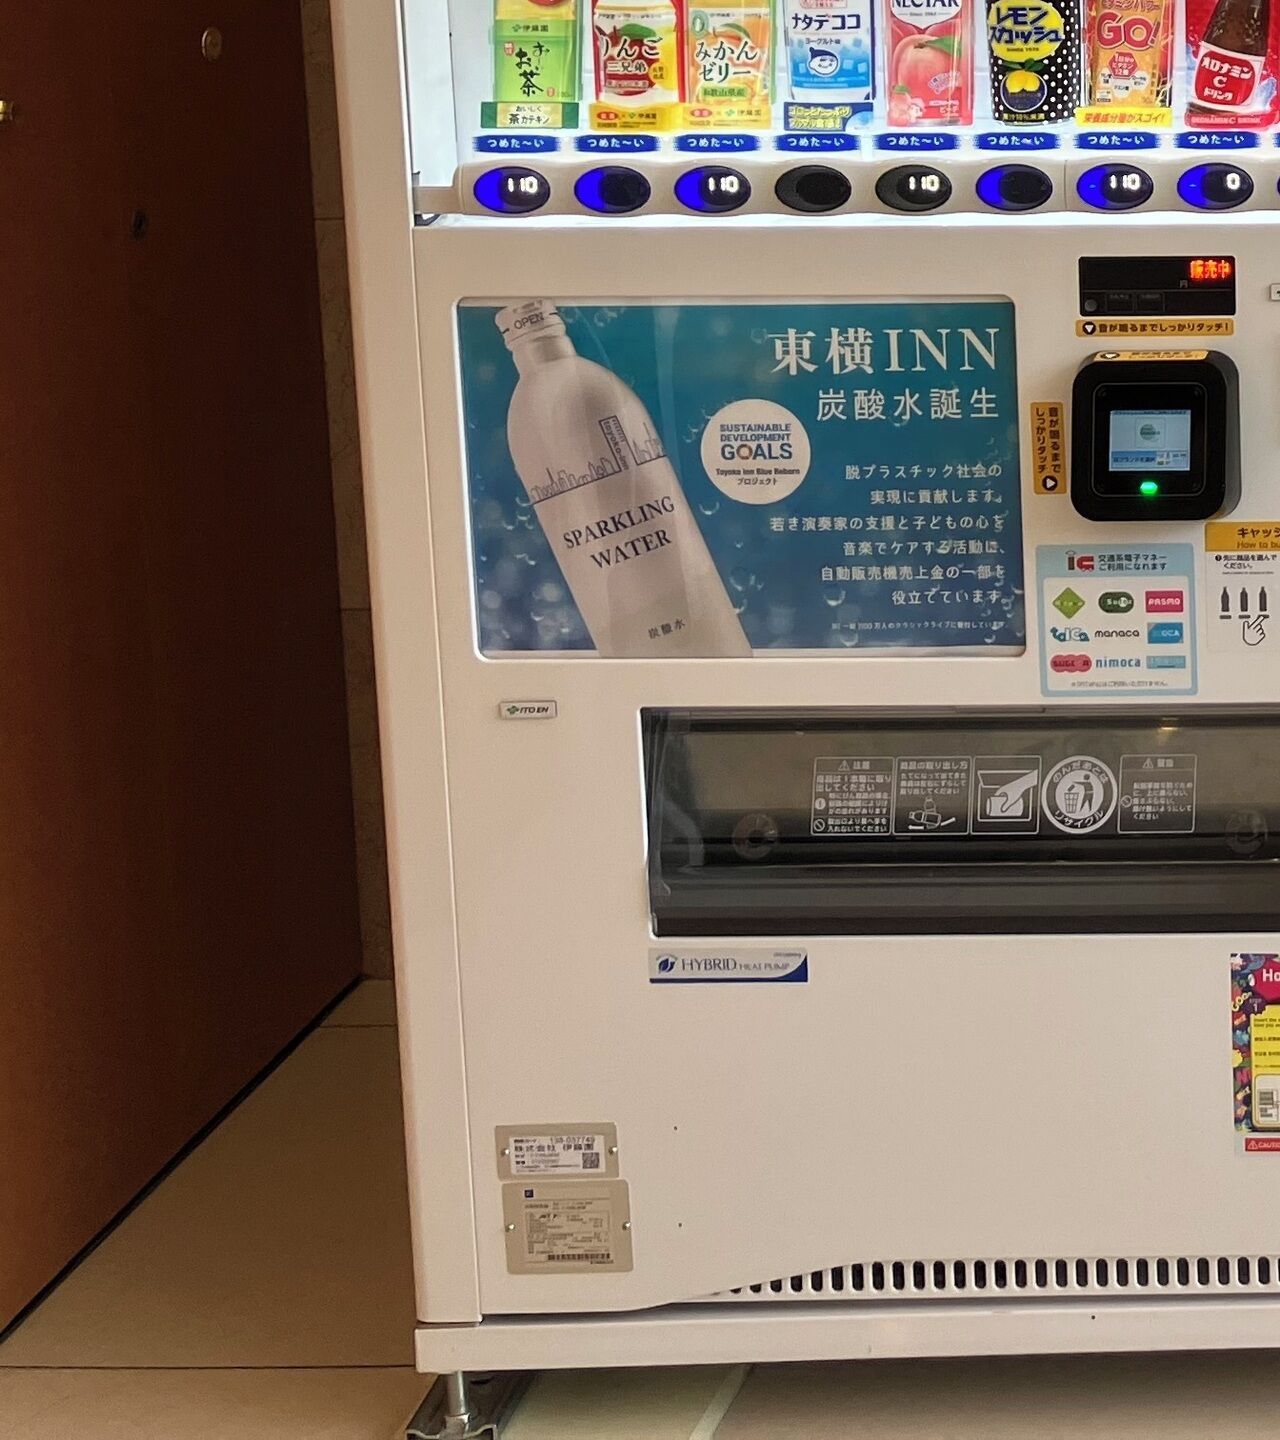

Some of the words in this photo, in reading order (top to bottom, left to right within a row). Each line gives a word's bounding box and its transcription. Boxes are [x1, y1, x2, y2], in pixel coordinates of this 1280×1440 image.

[996, 7, 1048, 26] レモン
[989, 25, 1063, 44] スカッシュ
[1099, 11, 1161, 51] GO!
[695, 40, 758, 62] みかん
[699, 62, 752, 83] ゼリー
[1201, 57, 1253, 80] オロナミン
[1213, 76, 1227, 88] C
[1189, 260, 1231, 280] 販売中
[513, 312, 545, 331] OPEN
[768, 326, 1000, 376] 東横INN
[816, 388, 1000, 423] 炭酸水誕生
[719, 423, 792, 433] SUSTAINABLE
[720, 433, 792, 442] DEVELOPMENT
[1035, 406, 1047, 473] しっかりタッチ
[1048, 406, 1062, 474] 音が鳴るまで
[720, 442, 793, 460] GOALS
[844, 462, 1002, 480] 脱プラスチック社会の
[870, 487, 1003, 505] 実現に貢献します。
[562, 494, 676, 550] SPARKLING
[769, 515, 1004, 534] 若き演奏家の支援と子どもの心を
[590, 527, 673, 571] WATER
[843, 538, 1005, 557] 音楽でケアする活動に、
[820, 564, 1005, 583] 自動販売機売上金の一部を
[1098, 562, 1168, 572] ご利用になれます
[890, 588, 1008, 606] 役立てています。
[1094, 629, 1140, 638] manaca
[1095, 656, 1141, 668] nimoca
[681, 957, 738, 972] HYBRID
